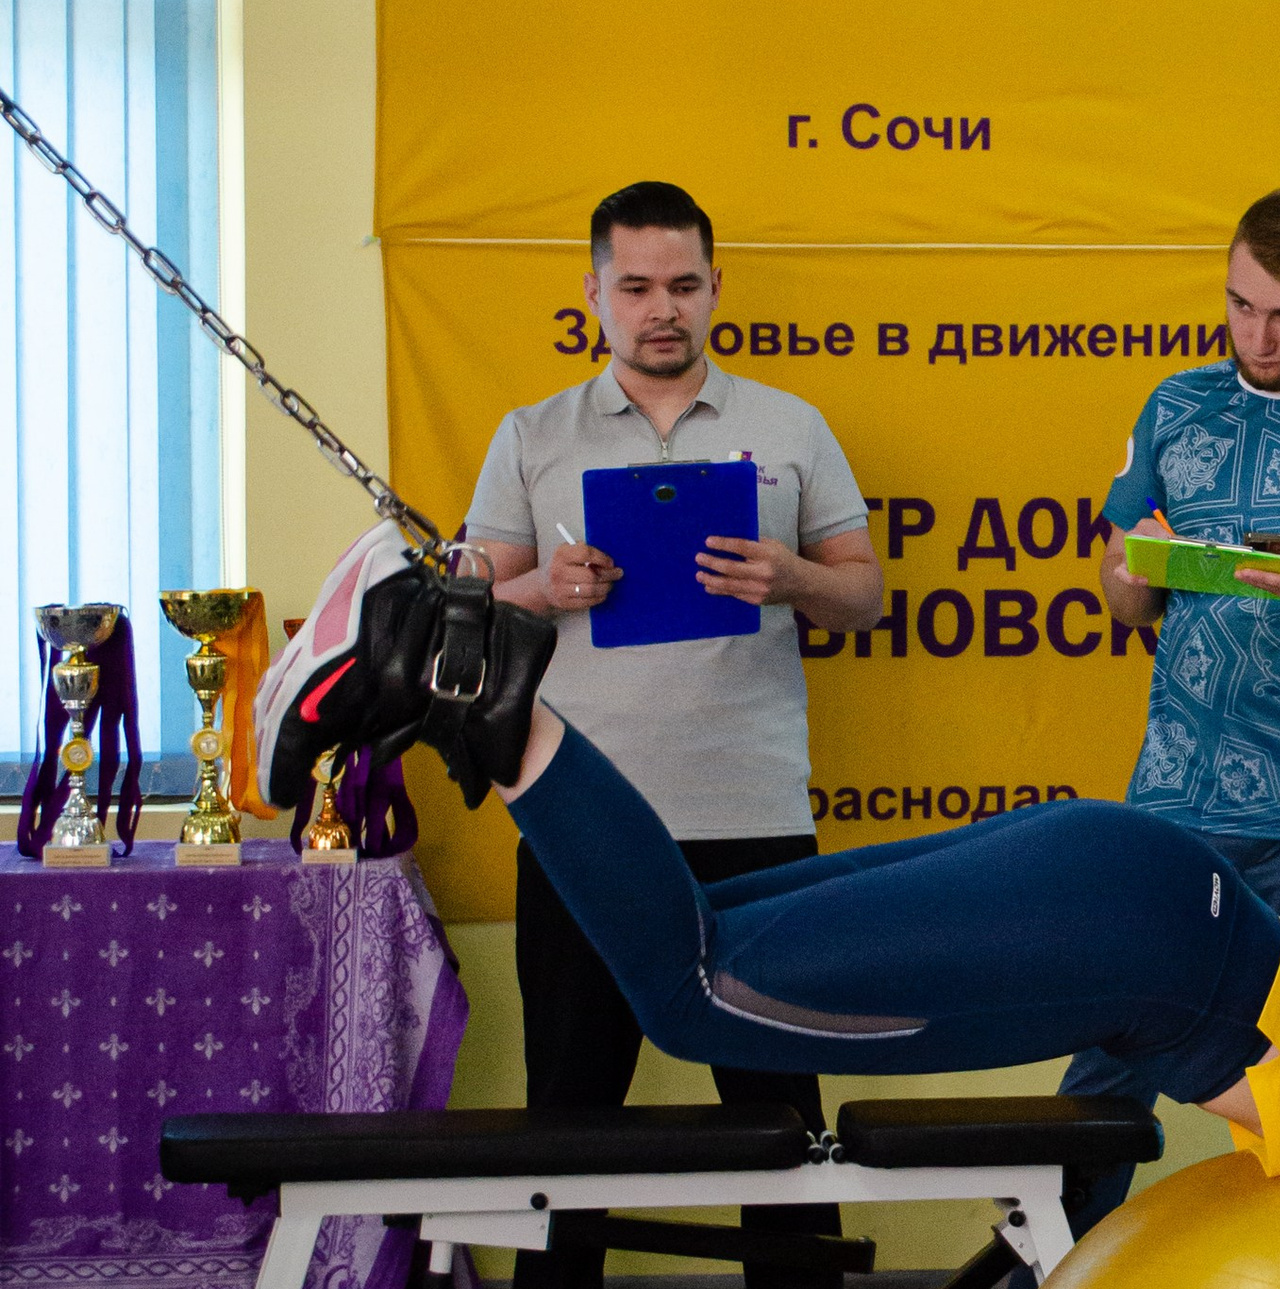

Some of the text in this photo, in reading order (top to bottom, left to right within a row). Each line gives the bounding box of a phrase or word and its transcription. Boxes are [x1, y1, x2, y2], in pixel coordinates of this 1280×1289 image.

[788, 103, 991, 151] г. Сочи
[877, 322, 910, 357] в
[928, 322, 1228, 365] движении
